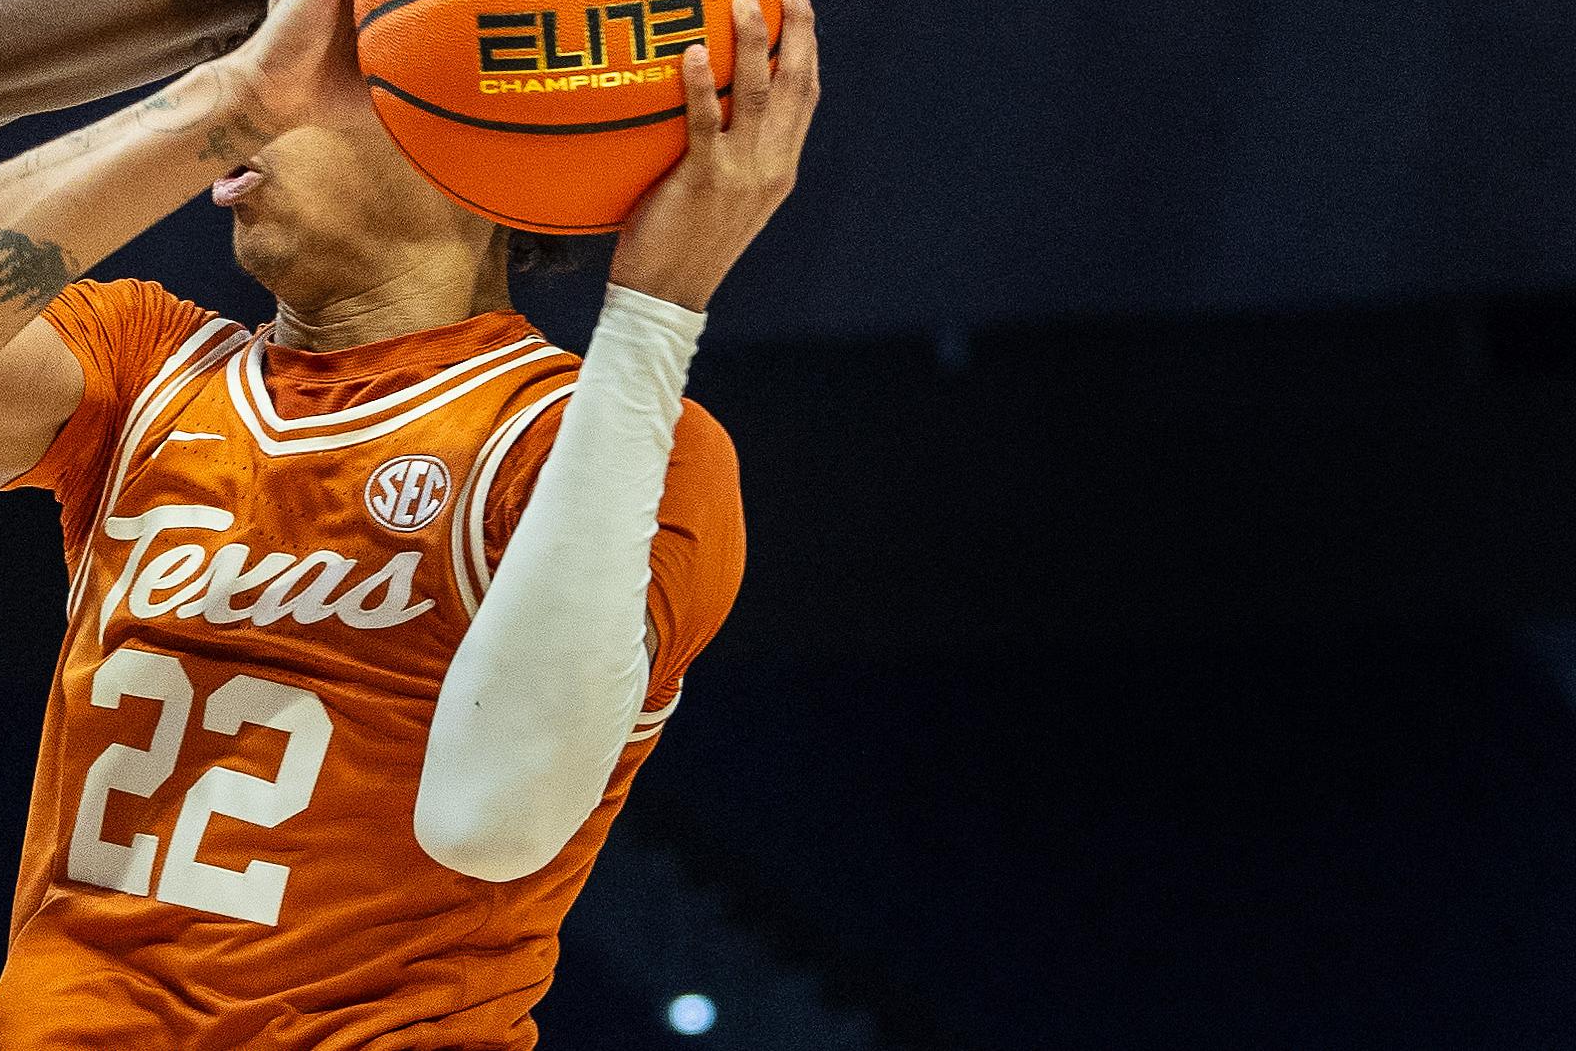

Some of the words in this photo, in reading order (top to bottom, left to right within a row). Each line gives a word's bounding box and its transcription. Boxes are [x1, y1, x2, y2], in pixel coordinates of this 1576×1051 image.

[372, 460, 445, 525] SEC
[98, 505, 436, 645] Texas
[68, 649, 334, 927] 22
